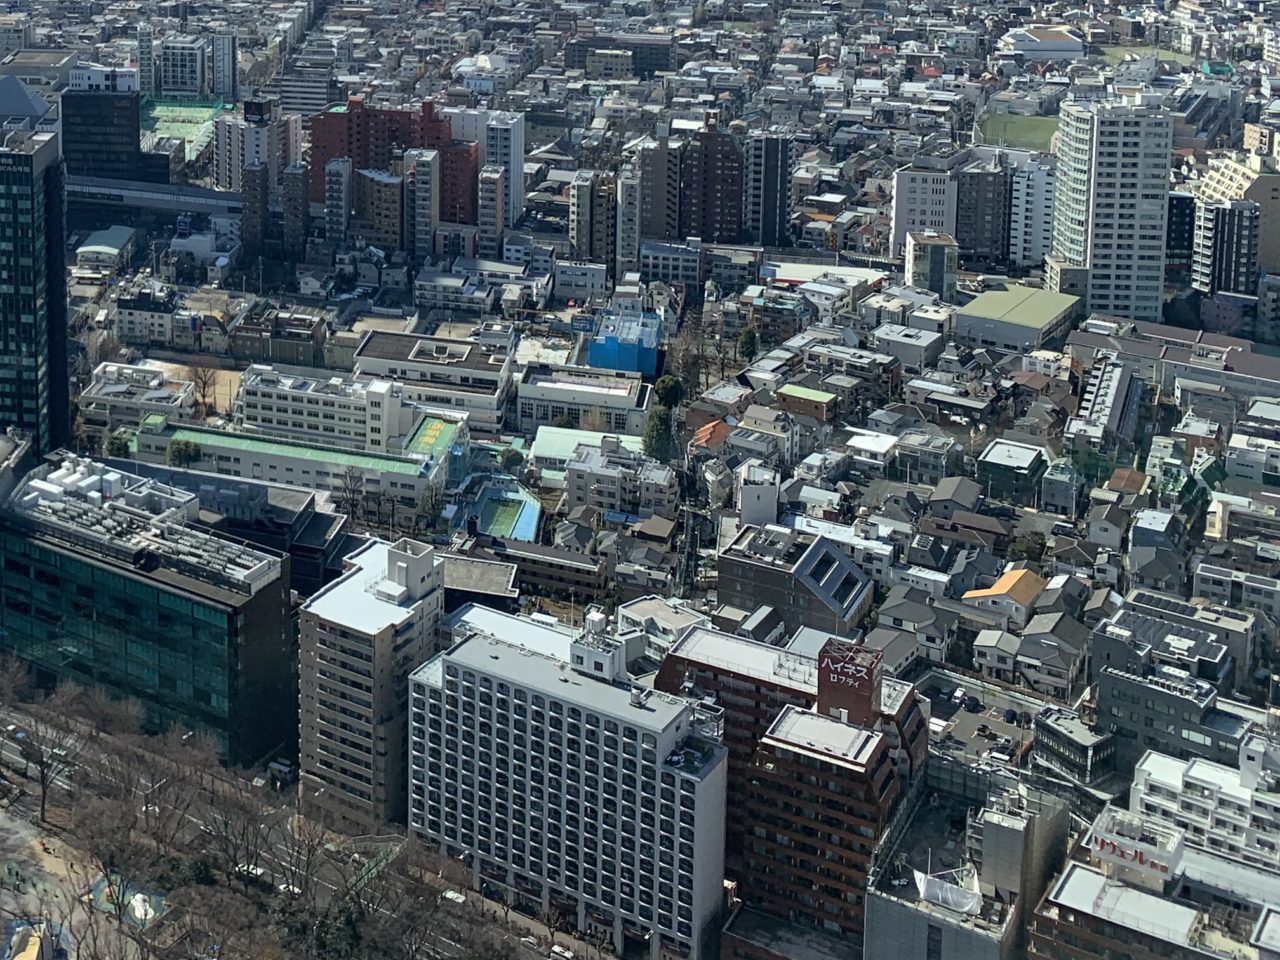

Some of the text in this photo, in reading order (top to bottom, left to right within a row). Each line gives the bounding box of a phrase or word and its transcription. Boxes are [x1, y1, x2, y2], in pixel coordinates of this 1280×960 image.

[821, 657, 869, 680] ハイネス
[830, 673, 860, 688] ロフティ
